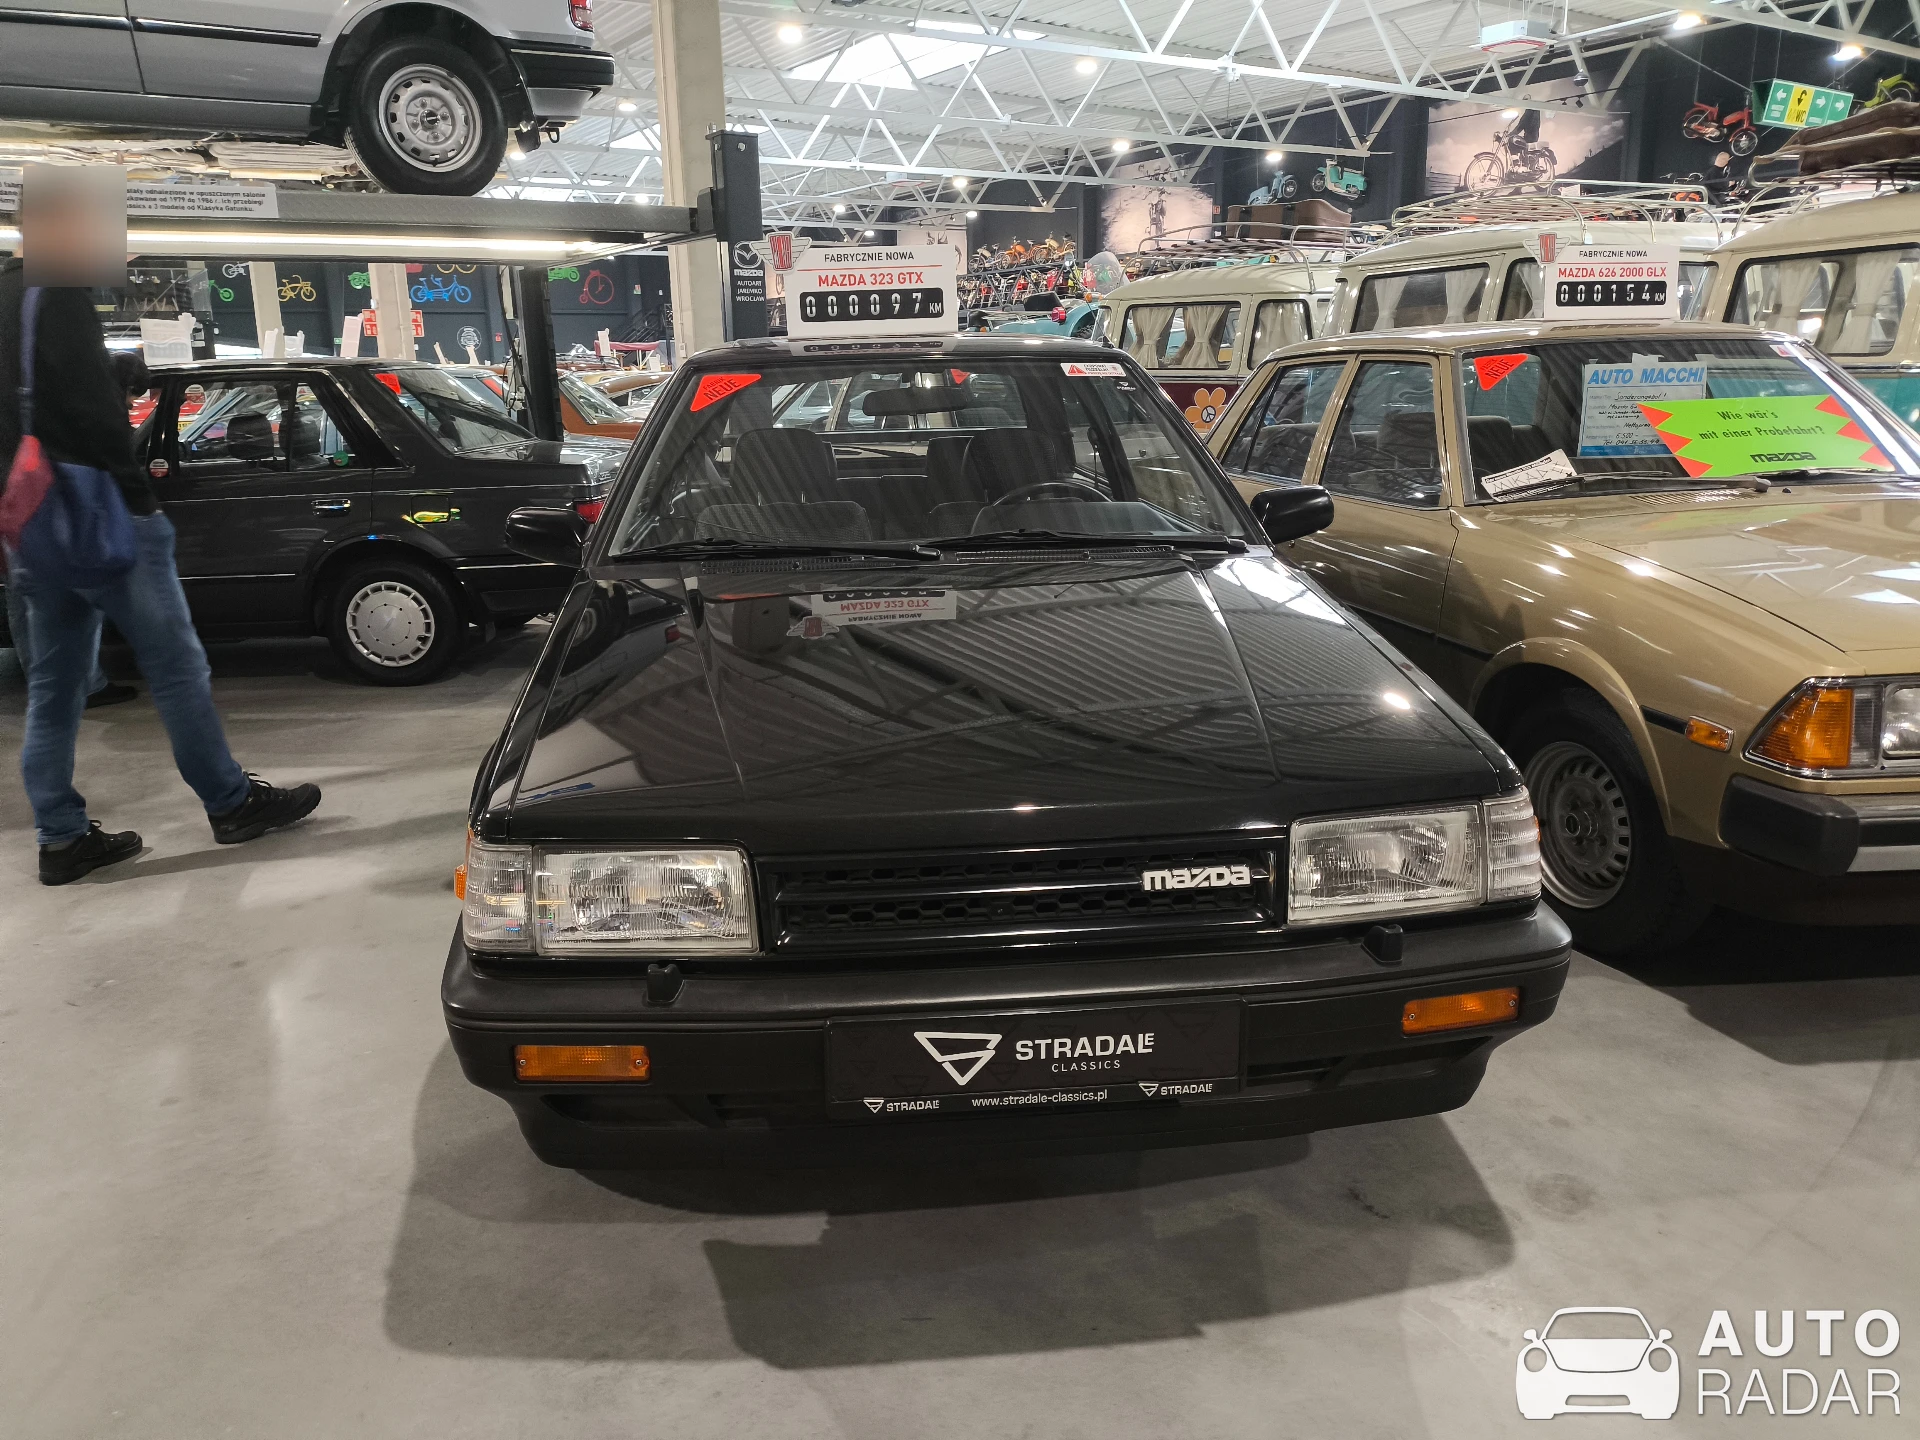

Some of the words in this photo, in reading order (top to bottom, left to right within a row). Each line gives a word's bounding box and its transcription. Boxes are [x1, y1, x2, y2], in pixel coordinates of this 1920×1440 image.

[824, 252, 883, 263] FABRYCZNIE
[886, 252, 914, 261] NOWA
[1579, 250, 1624, 258] FABRYCZNIE
[1626, 250, 1648, 258] NOWA
[734, 269, 763, 277] mazda
[1558, 268, 1596, 278] MAZDA
[1599, 268, 1617, 278] 626
[1620, 267, 1644, 278] 2000
[1646, 266, 1667, 277] GLX
[818, 274, 867, 287] MAZDA
[870, 273, 894, 285] 323
[898, 272, 924, 285] GTX
[1655, 292, 1665, 302] KM
[929, 303, 942, 314] KM
[1587, 368, 1634, 385] AUTO
[1640, 367, 1705, 384] MACCHI
[704, 378, 742, 401] NEUE
[1717, 410, 1742, 421] Wie
[1747, 409, 1779, 420] wär's
[1698, 431, 1718, 441] mit
[1722, 428, 1753, 439] einer
[1756, 425, 1825, 437] Probefahrt?
[1750, 452, 1817, 463] mazda
[1143, 864, 1251, 891] mazda
[1015, 1032, 1155, 1061] STRADALE
[1051, 1060, 1121, 1073] CLASSICS
[1160, 1083, 1213, 1096] STRADALE
[972, 1090, 1108, 1108] www.stradale-classics.pl
[886, 1100, 940, 1112] STRADALE
